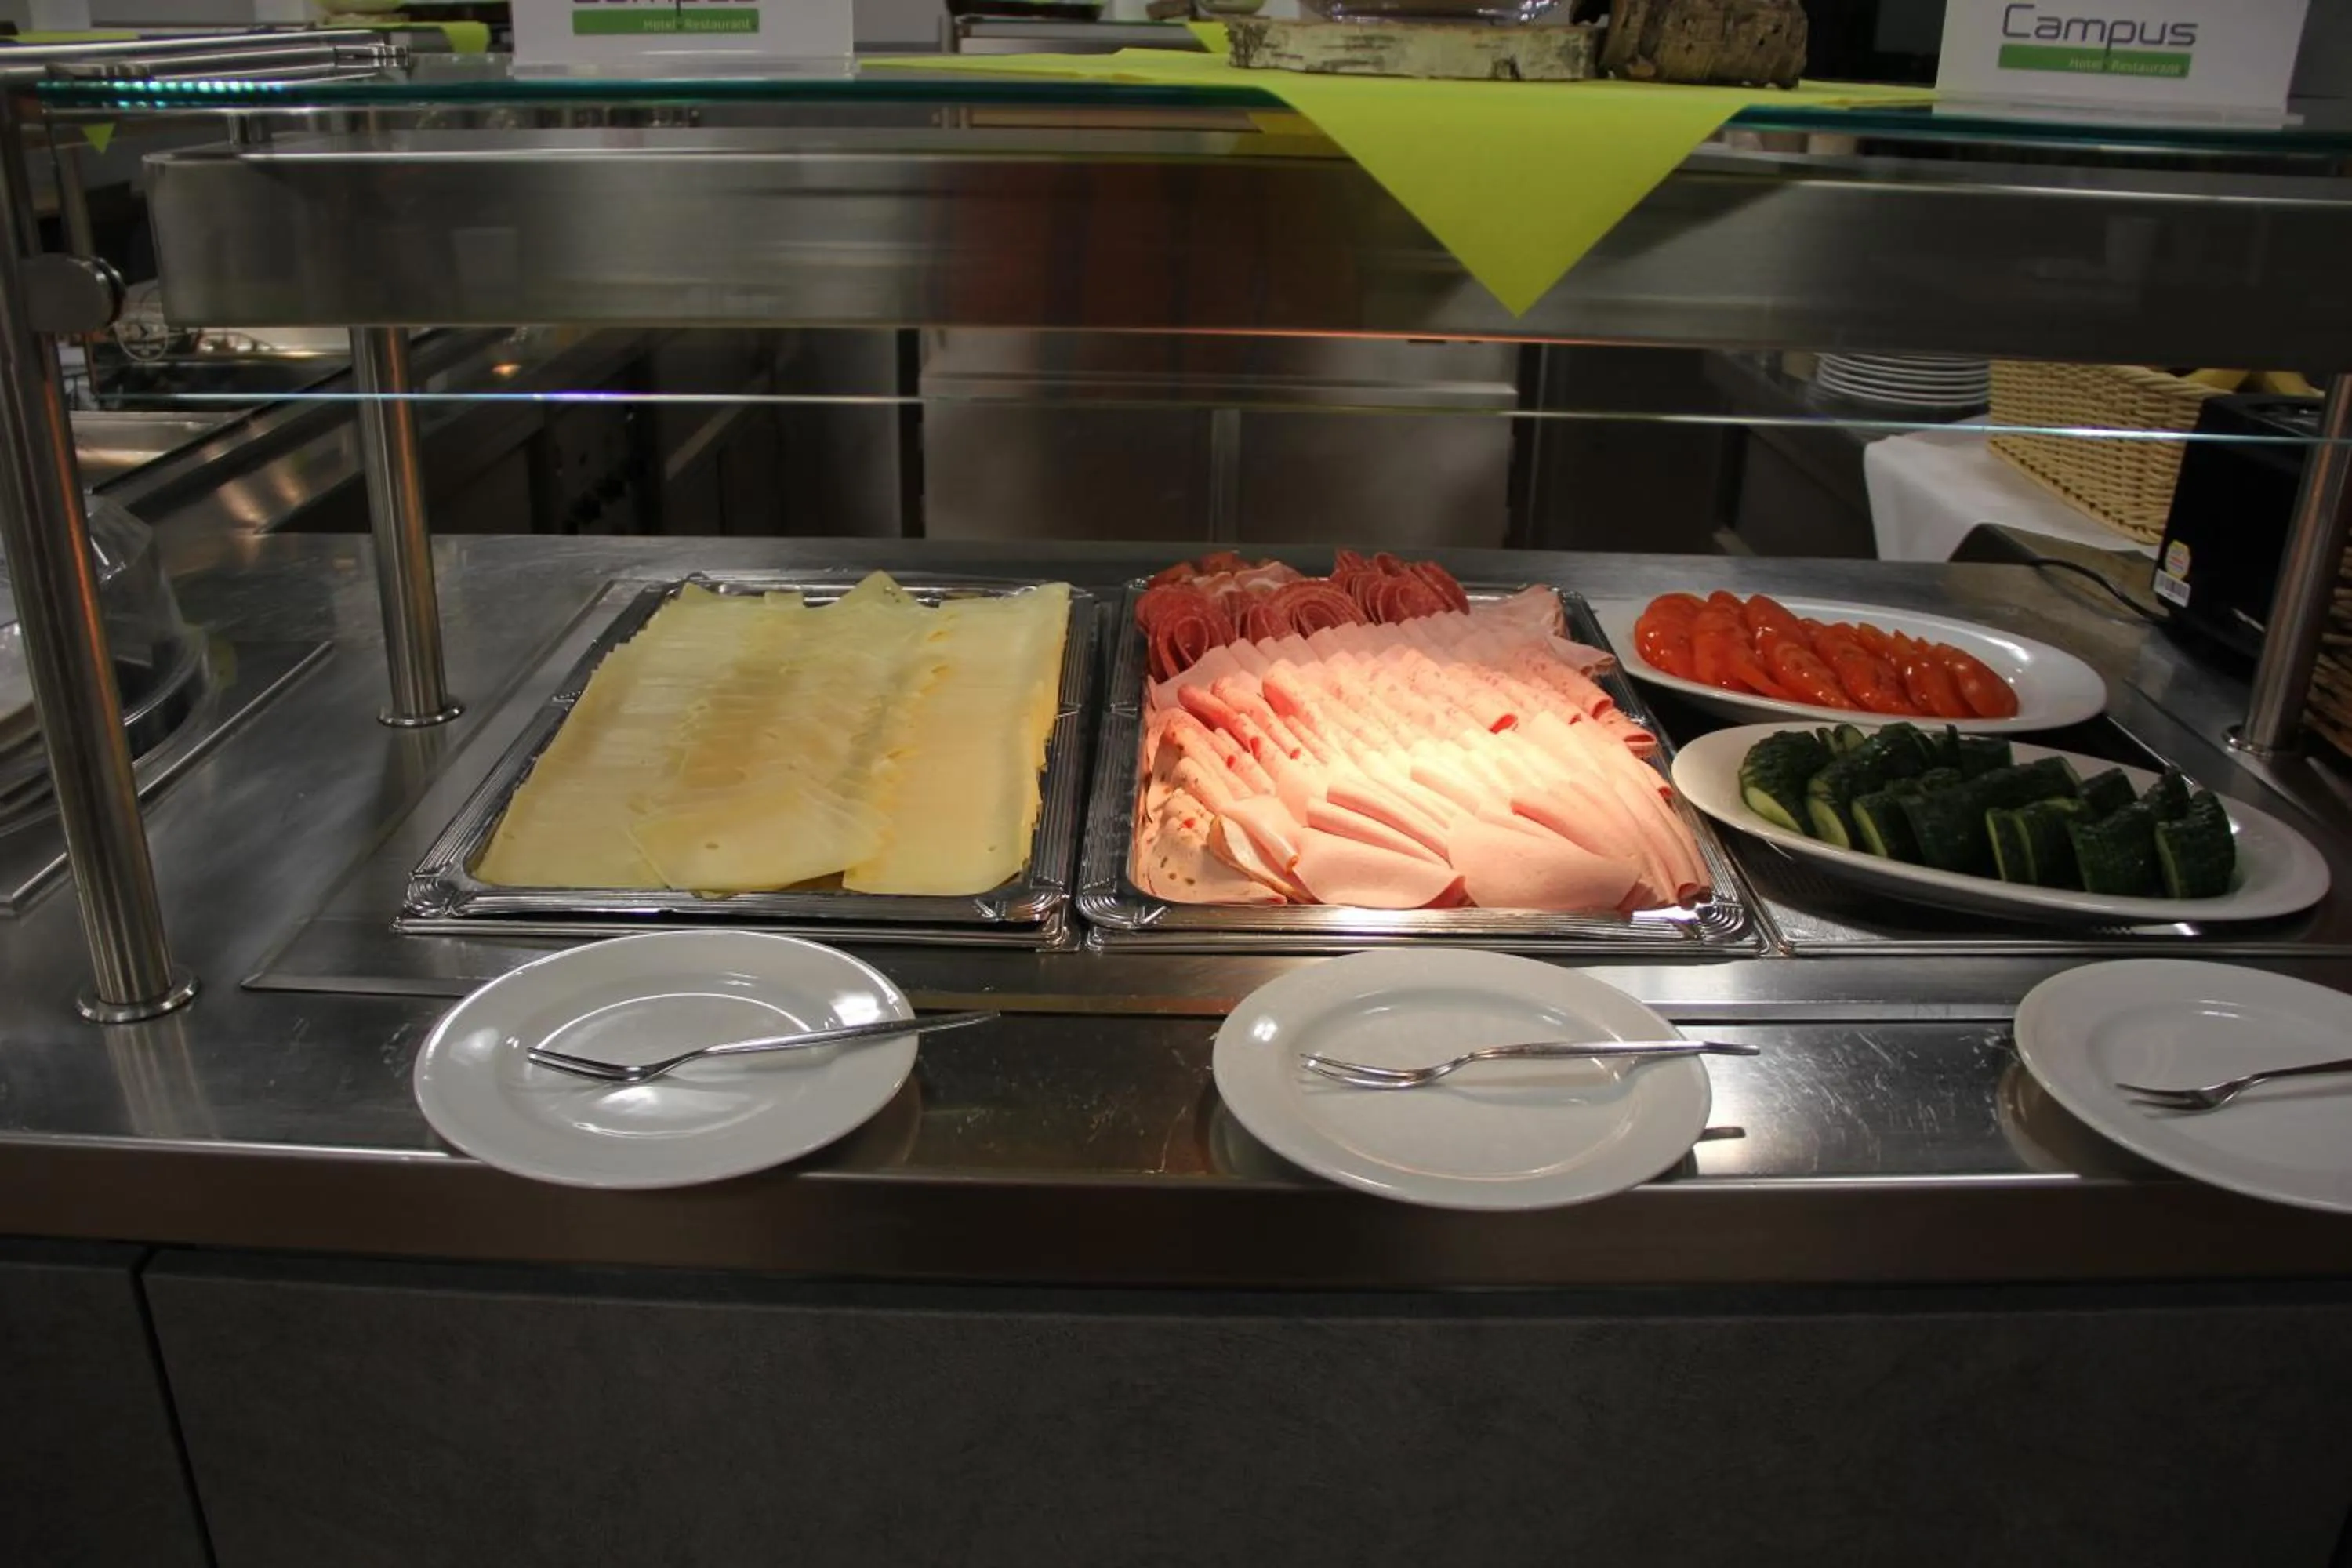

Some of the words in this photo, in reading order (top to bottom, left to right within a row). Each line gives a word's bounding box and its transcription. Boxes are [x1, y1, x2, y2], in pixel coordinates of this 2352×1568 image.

[643, 18, 675, 29] Hotel
[684, 17, 750, 29] Restaurant
[2003, 4, 2198, 56] Campus
[2070, 57, 2102, 71] Hotel
[2111, 60, 2180, 74] Restaurant
